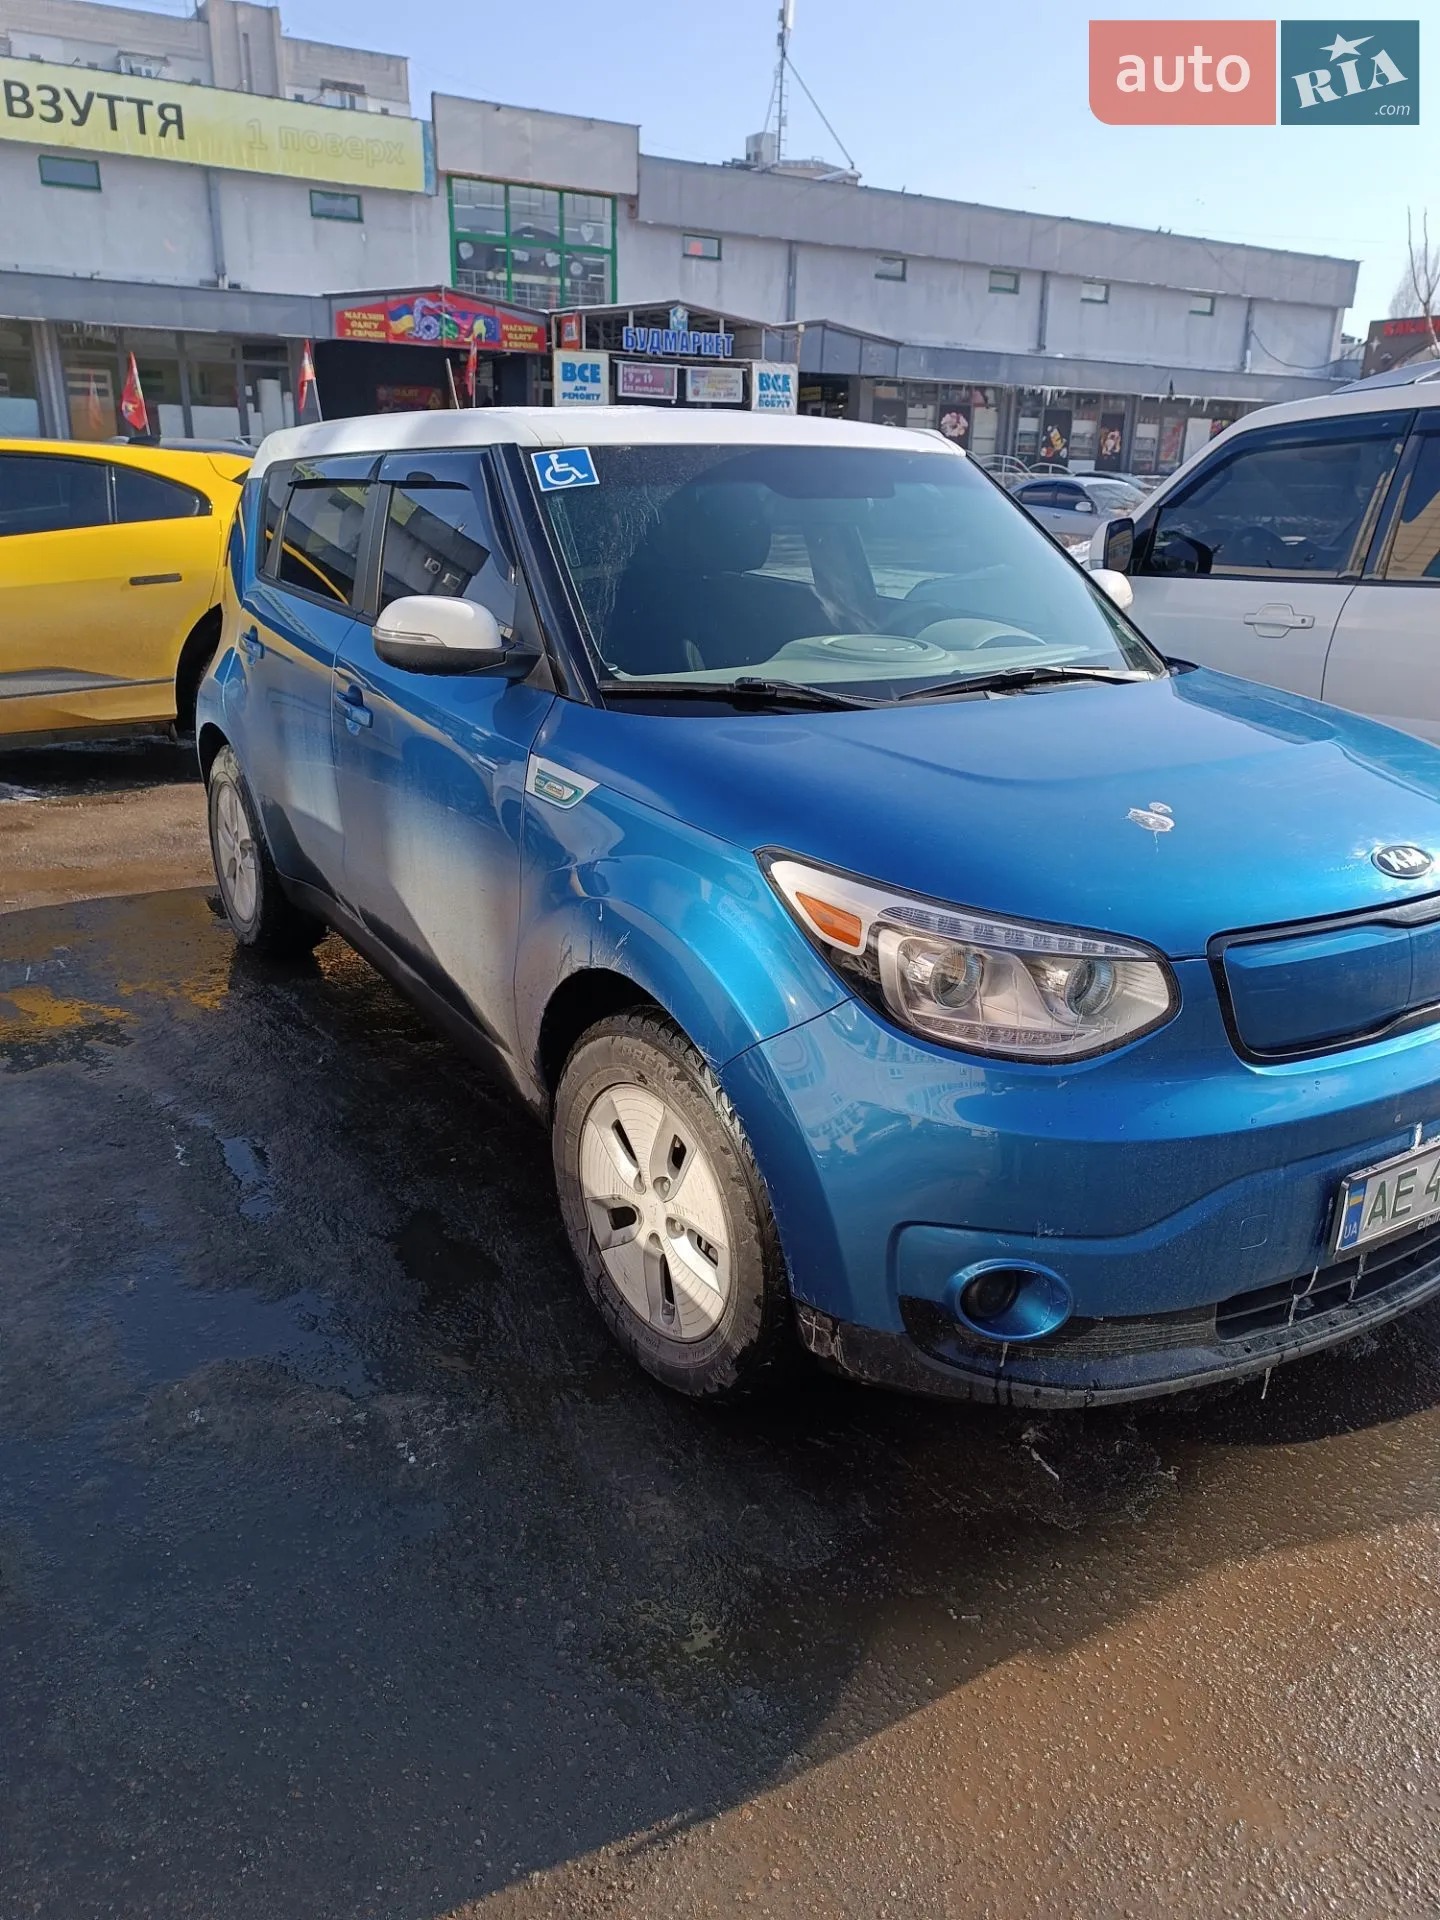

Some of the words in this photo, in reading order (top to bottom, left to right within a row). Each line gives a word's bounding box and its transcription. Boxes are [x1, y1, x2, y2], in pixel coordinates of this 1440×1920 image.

[3, 79, 185, 140] ВЗУТТЯ
[246, 118, 268, 151] 1
[278, 125, 405, 168] поверх
[623, 326, 735, 356] БУДМАРКЕТ
[562, 361, 601, 383] ВСЕ
[644, 373, 653, 383] 19
[758, 373, 790, 392] ВСЕ
[561, 391, 601, 401] РЕМОНТУ
[1379, 848, 1430, 872] KIA
[1362, 1166, 1418, 1231] AE
[1343, 1221, 1357, 1239] UA
